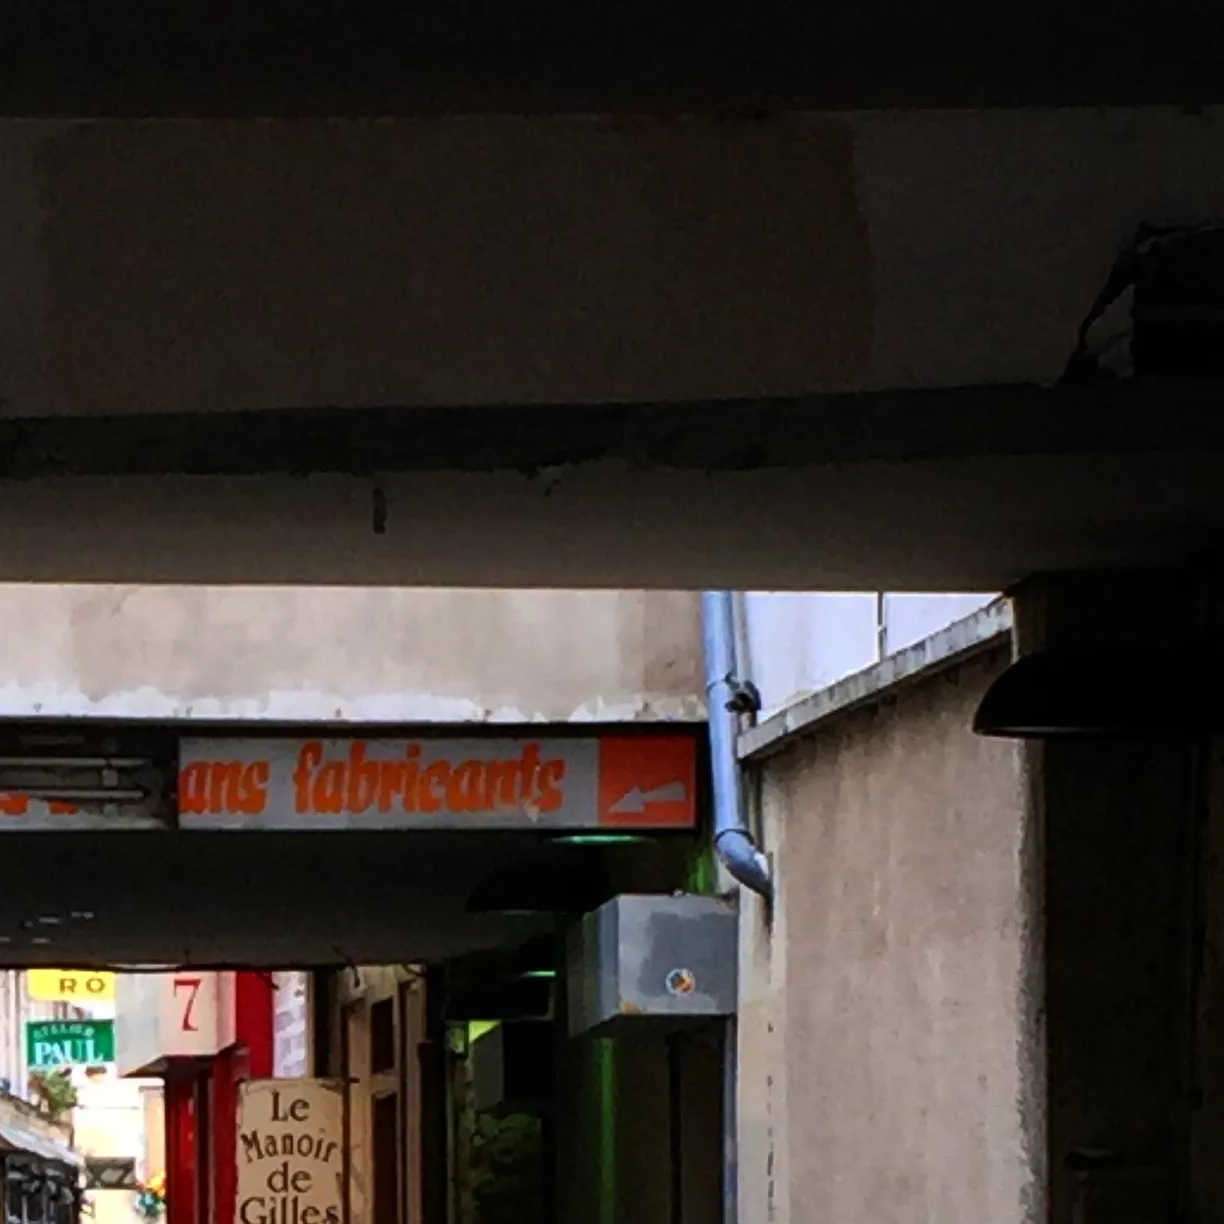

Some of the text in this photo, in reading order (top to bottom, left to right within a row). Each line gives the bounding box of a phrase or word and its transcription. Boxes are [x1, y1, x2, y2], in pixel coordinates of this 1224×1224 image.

[293, 740, 566, 814] fabricants
[174, 978, 202, 1032] 7
[34, 1039, 103, 1065] PAUL
[271, 1091, 311, 1122] Le
[241, 1128, 339, 1164] Manoir
[266, 1161, 312, 1193] de
